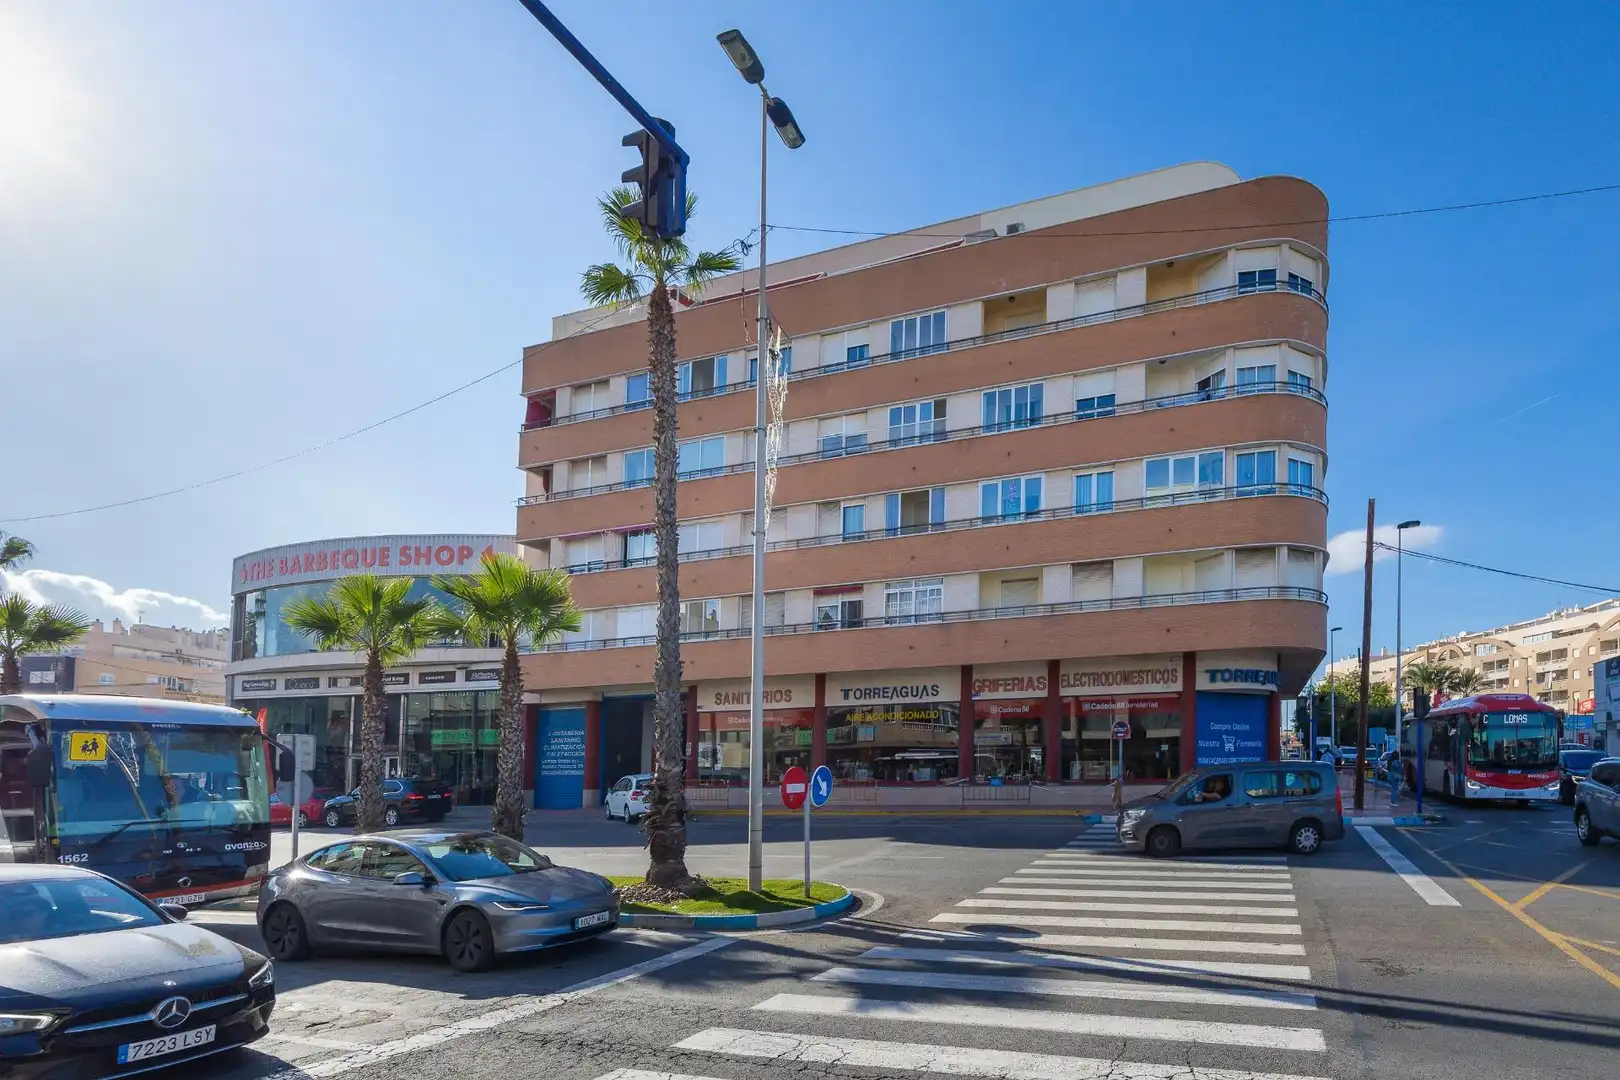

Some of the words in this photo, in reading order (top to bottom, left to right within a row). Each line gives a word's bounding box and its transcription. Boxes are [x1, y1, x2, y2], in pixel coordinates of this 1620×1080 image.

[249, 559, 275, 581] THE
[279, 546, 391, 576] BARBEQUE
[399, 545, 474, 566] SHOP
[972, 676, 1047, 693] GRIFERIAS
[1061, 668, 1178, 688] ELECTRODOMESTICOS
[714, 689, 792, 706] SANITRIOS
[840, 684, 940, 701] TORREAGUAS
[845, 712, 865, 722] AIRE
[865, 710, 939, 722] ACONDICIONADO
[1483, 714, 1489, 724] C
[1503, 714, 1528, 724] LOMAS
[225, 841, 260, 851] avanza
[57, 853, 89, 863] 1562
[132, 1037, 177, 1059] 7223
[183, 1028, 212, 1047] LSY
